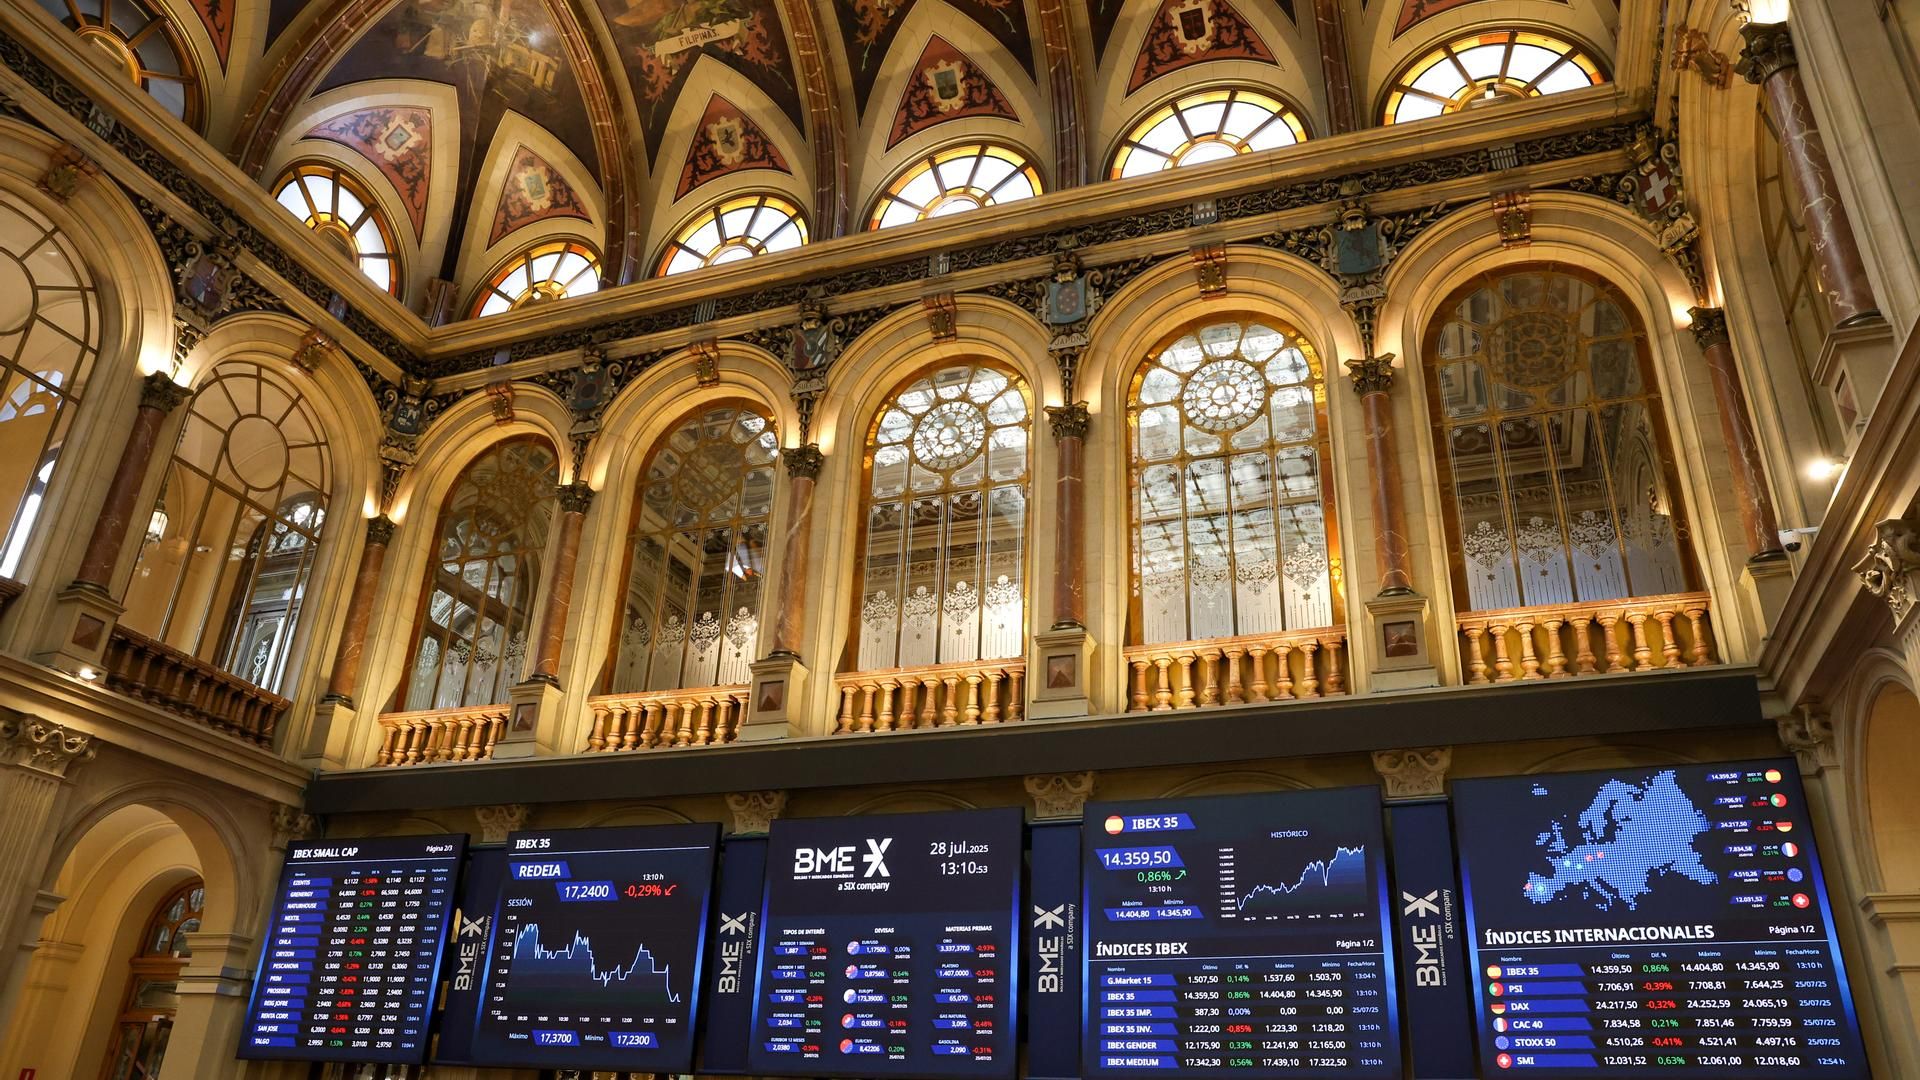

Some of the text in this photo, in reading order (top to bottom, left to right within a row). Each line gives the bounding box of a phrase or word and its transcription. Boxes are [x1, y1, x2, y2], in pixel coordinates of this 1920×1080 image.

[679, 29, 719, 46] FILIPINAS.
[1347, 289, 1380, 300] HOLANDA
[1132, 818, 1178, 829] IBEX 35
[1271, 830, 1308, 838] HISTÓRICO
[426, 845, 443, 853] Página
[516, 839, 550, 848] IBEX 35
[930, 842, 946, 854] 28
[293, 848, 358, 858] IBEX SMALL CAP
[1104, 851, 1170, 866] 14.359,50
[794, 846, 856, 873] BME
[519, 864, 561, 876] REDEIA
[1138, 870, 1171, 882] 0,86%
[565, 884, 661, 898] 17,2400 -0,29%
[844, 882, 855, 890] SIX
[857, 882, 890, 891] company
[508, 898, 532, 906] SESIÓN
[1443, 889, 1451, 920] company
[1116, 908, 1191, 918] 14.404,80 14.345,90
[1445, 923, 1453, 934] SIX
[1769, 925, 1815, 935] Página 1/2
[1485, 925, 1714, 945] ÍNDICES INTERNACIONALES
[1096, 942, 1188, 956] ÍNDICES IBEX
[1336, 940, 1360, 949] Página
[1412, 925, 1440, 986] BME
[454, 943, 476, 990] BME
[718, 942, 739, 993] BME
[1038, 936, 1058, 992] BME
[1507, 961, 1779, 975] IBEX 35 14.359,50 0,86% 14.404,80 14.345,90
[1108, 977, 1140, 985] G.Market
[1188, 975, 1218, 984] 1.507,50
[1227, 975, 1250, 983] 0,14%
[1264, 974, 1295, 983] 1.537,60
[1309, 973, 1341, 982] 1.503,70
[1509, 979, 1827, 993] PSI 7.706,91 -0,39% 7.708,81 7.644,25 25/07/25
[1184, 991, 1219, 1000] 14.359,50
[1228, 991, 1250, 999] 0,86%
[1260, 990, 1296, 999] 14.404,80
[1306, 989, 1342, 998] 14.345,90
[1511, 998, 1831, 1011] DAX 24.217,50 -0,32% 24.252,59 24.065,19 25/07/25
[1195, 1008, 1219, 1017] 387,30
[1228, 1008, 1250, 1016] 0,00%
[1280, 1007, 1296, 1016] 0,00
[1327, 1006, 1343, 1015] 0,00
[1190, 1024, 1220, 1034] 1.222,00
[1226, 1025, 1252, 1033] -0,85%
[1266, 1024, 1297, 1033] 1.223,30
[1312, 1024, 1344, 1032] 1.218,20
[1513, 1017, 1835, 1029] CAC 40 7.834,58 0,21% 7.851,46 7.759,59 25/07/25
[541, 1033, 572, 1043] 17,3700
[617, 1035, 649, 1045] 17,2300
[1185, 1041, 1220, 1050] 12.175,90
[1229, 1042, 1252, 1050] 0,33%
[1262, 1041, 1298, 1050] 12.241,90
[1308, 1040, 1345, 1050] 12.165,00
[1515, 1036, 1840, 1047] STOXX 50 4.510,26 -0,41% 4.521,41 4.497,16 25/07/25
[1108, 1058, 1346, 1067] IBEX MEDIUM 17.342,30 0,56% 17.439,10 17.322,50
[1517, 1055, 1800, 1067] SMI 12.031,52 0,63% 12.061,00 12.018,60
